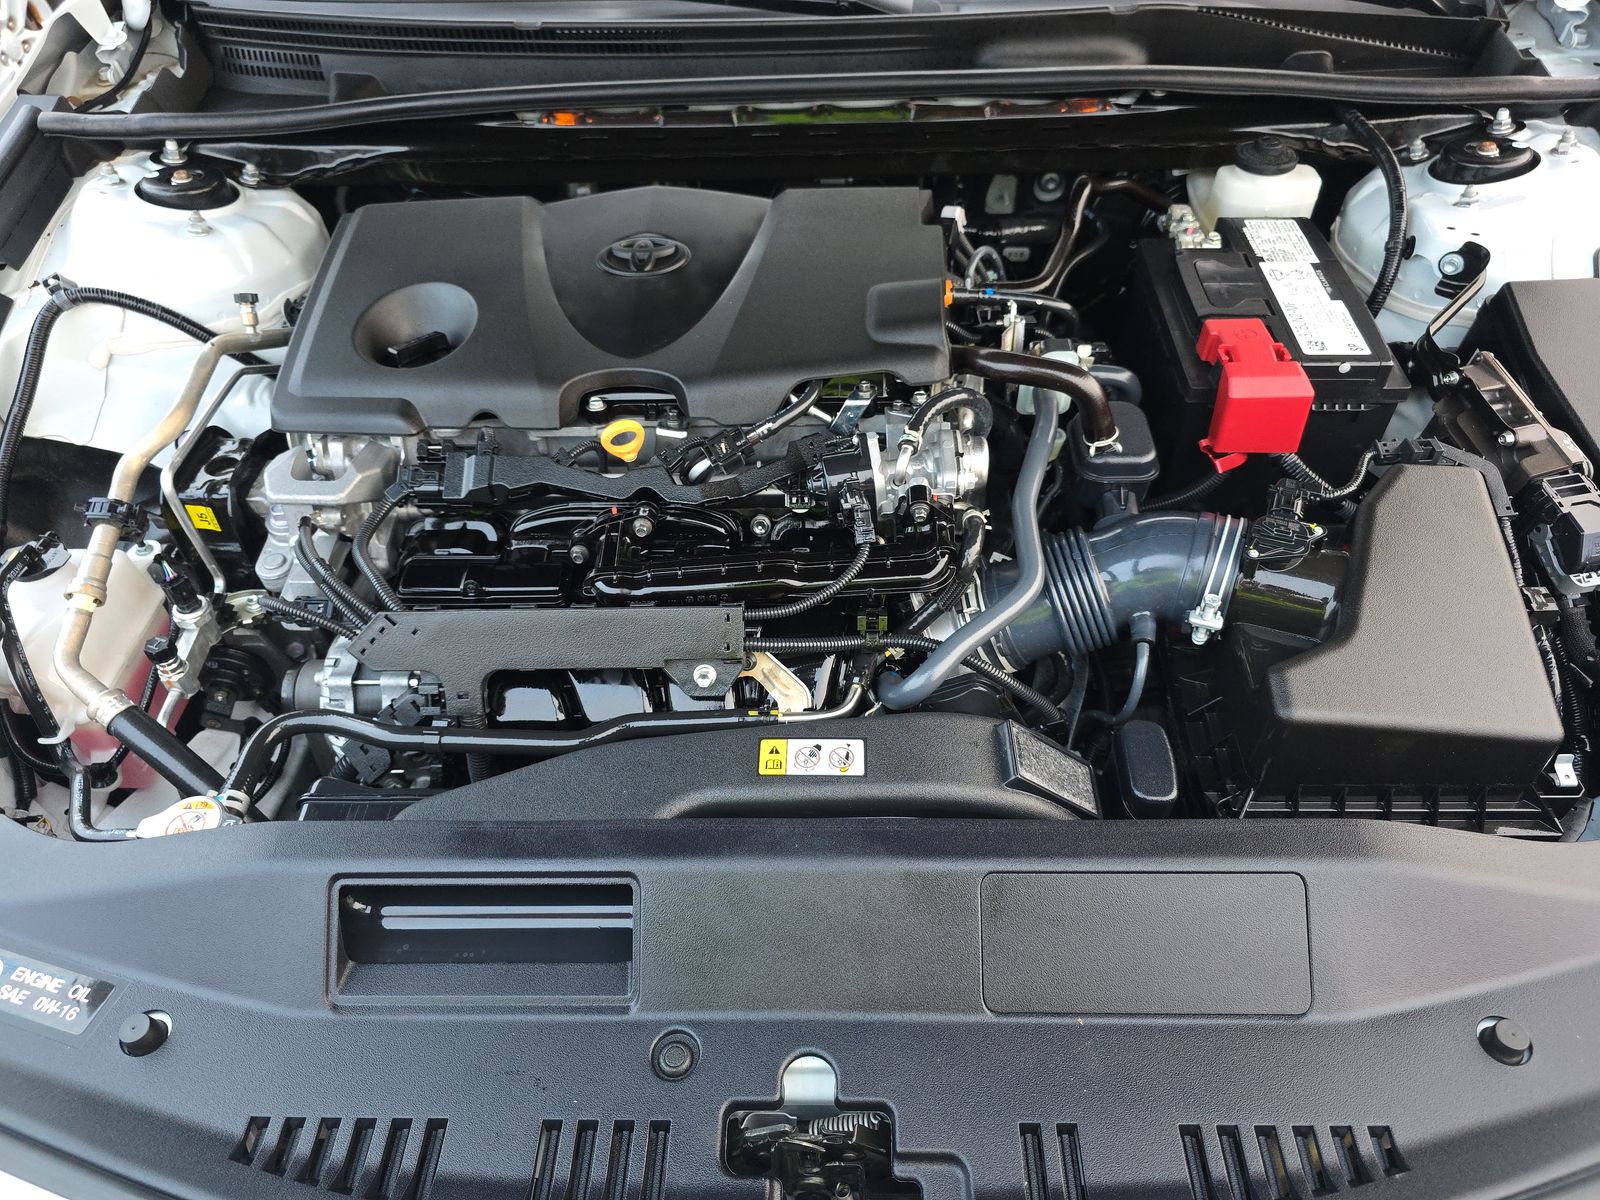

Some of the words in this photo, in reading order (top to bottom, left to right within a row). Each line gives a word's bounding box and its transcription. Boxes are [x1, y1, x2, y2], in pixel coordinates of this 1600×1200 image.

[196, 512, 211, 526] J5
[10, 966, 66, 994] ENGINE
[67, 984, 92, 1003] OIL
[0, 985, 31, 1005] SAE
[32, 996, 80, 1021] 0W-16
